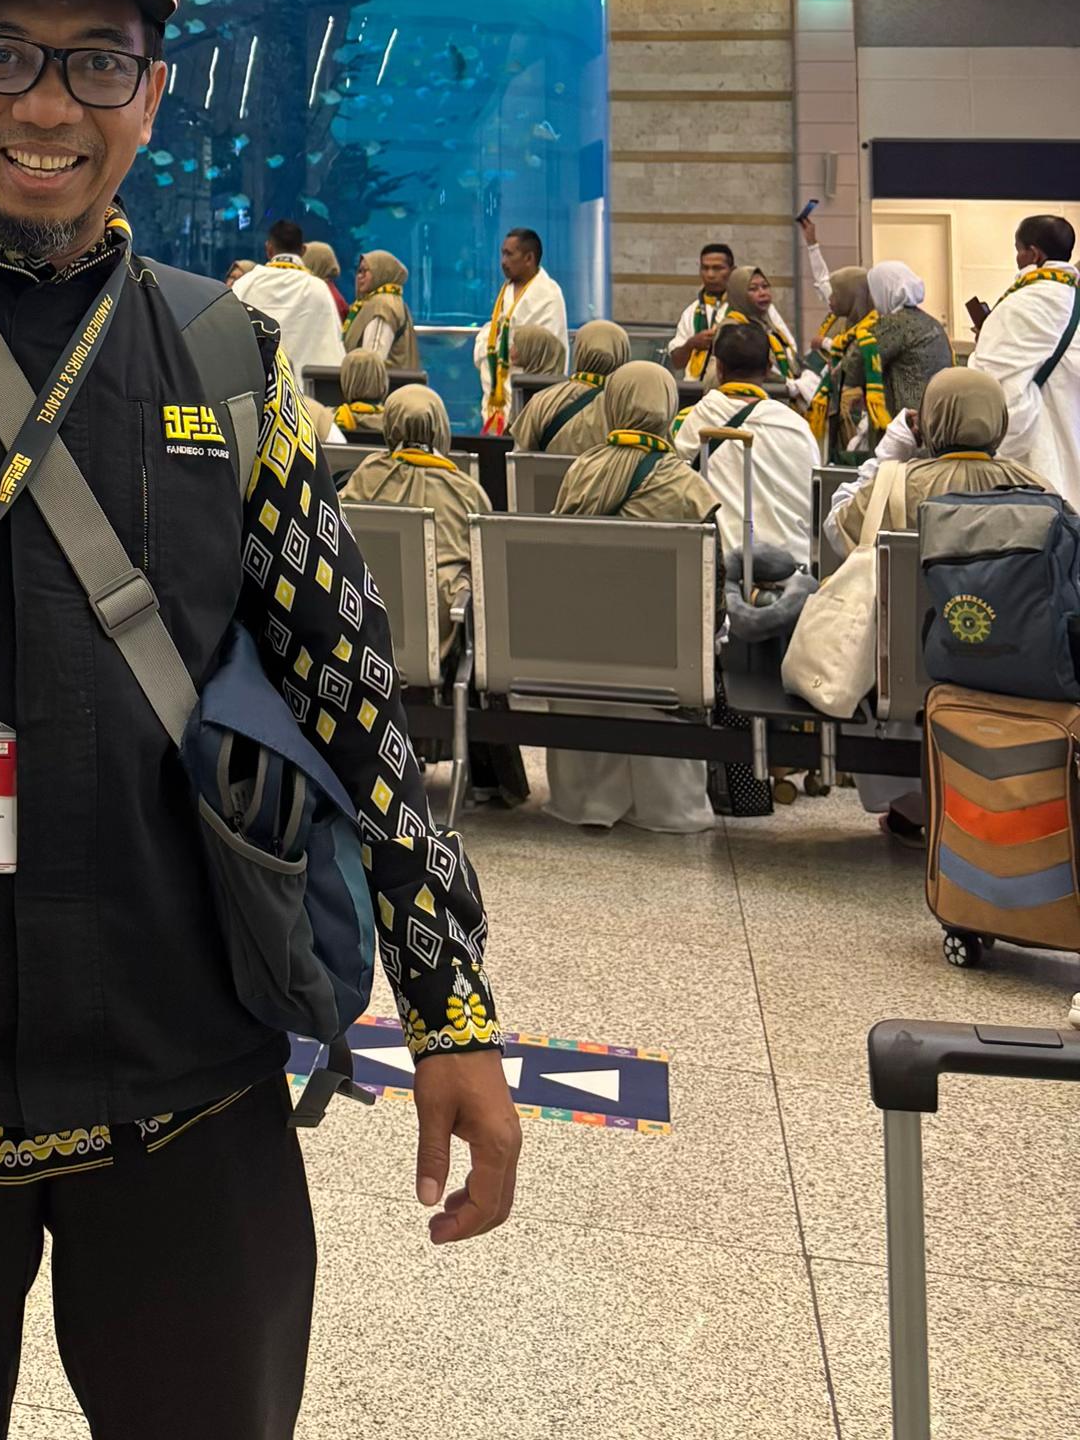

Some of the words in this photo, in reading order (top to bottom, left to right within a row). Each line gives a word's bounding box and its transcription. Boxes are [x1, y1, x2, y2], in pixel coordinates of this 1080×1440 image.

[82, 293, 113, 344] FANDIEGO
[64, 340, 93, 377] TOURS
[59, 372, 74, 385] &
[36, 382, 70, 424] TRAVEL
[166, 445, 205, 456] FANDIEGO
[206, 448, 230, 460] TOURS
